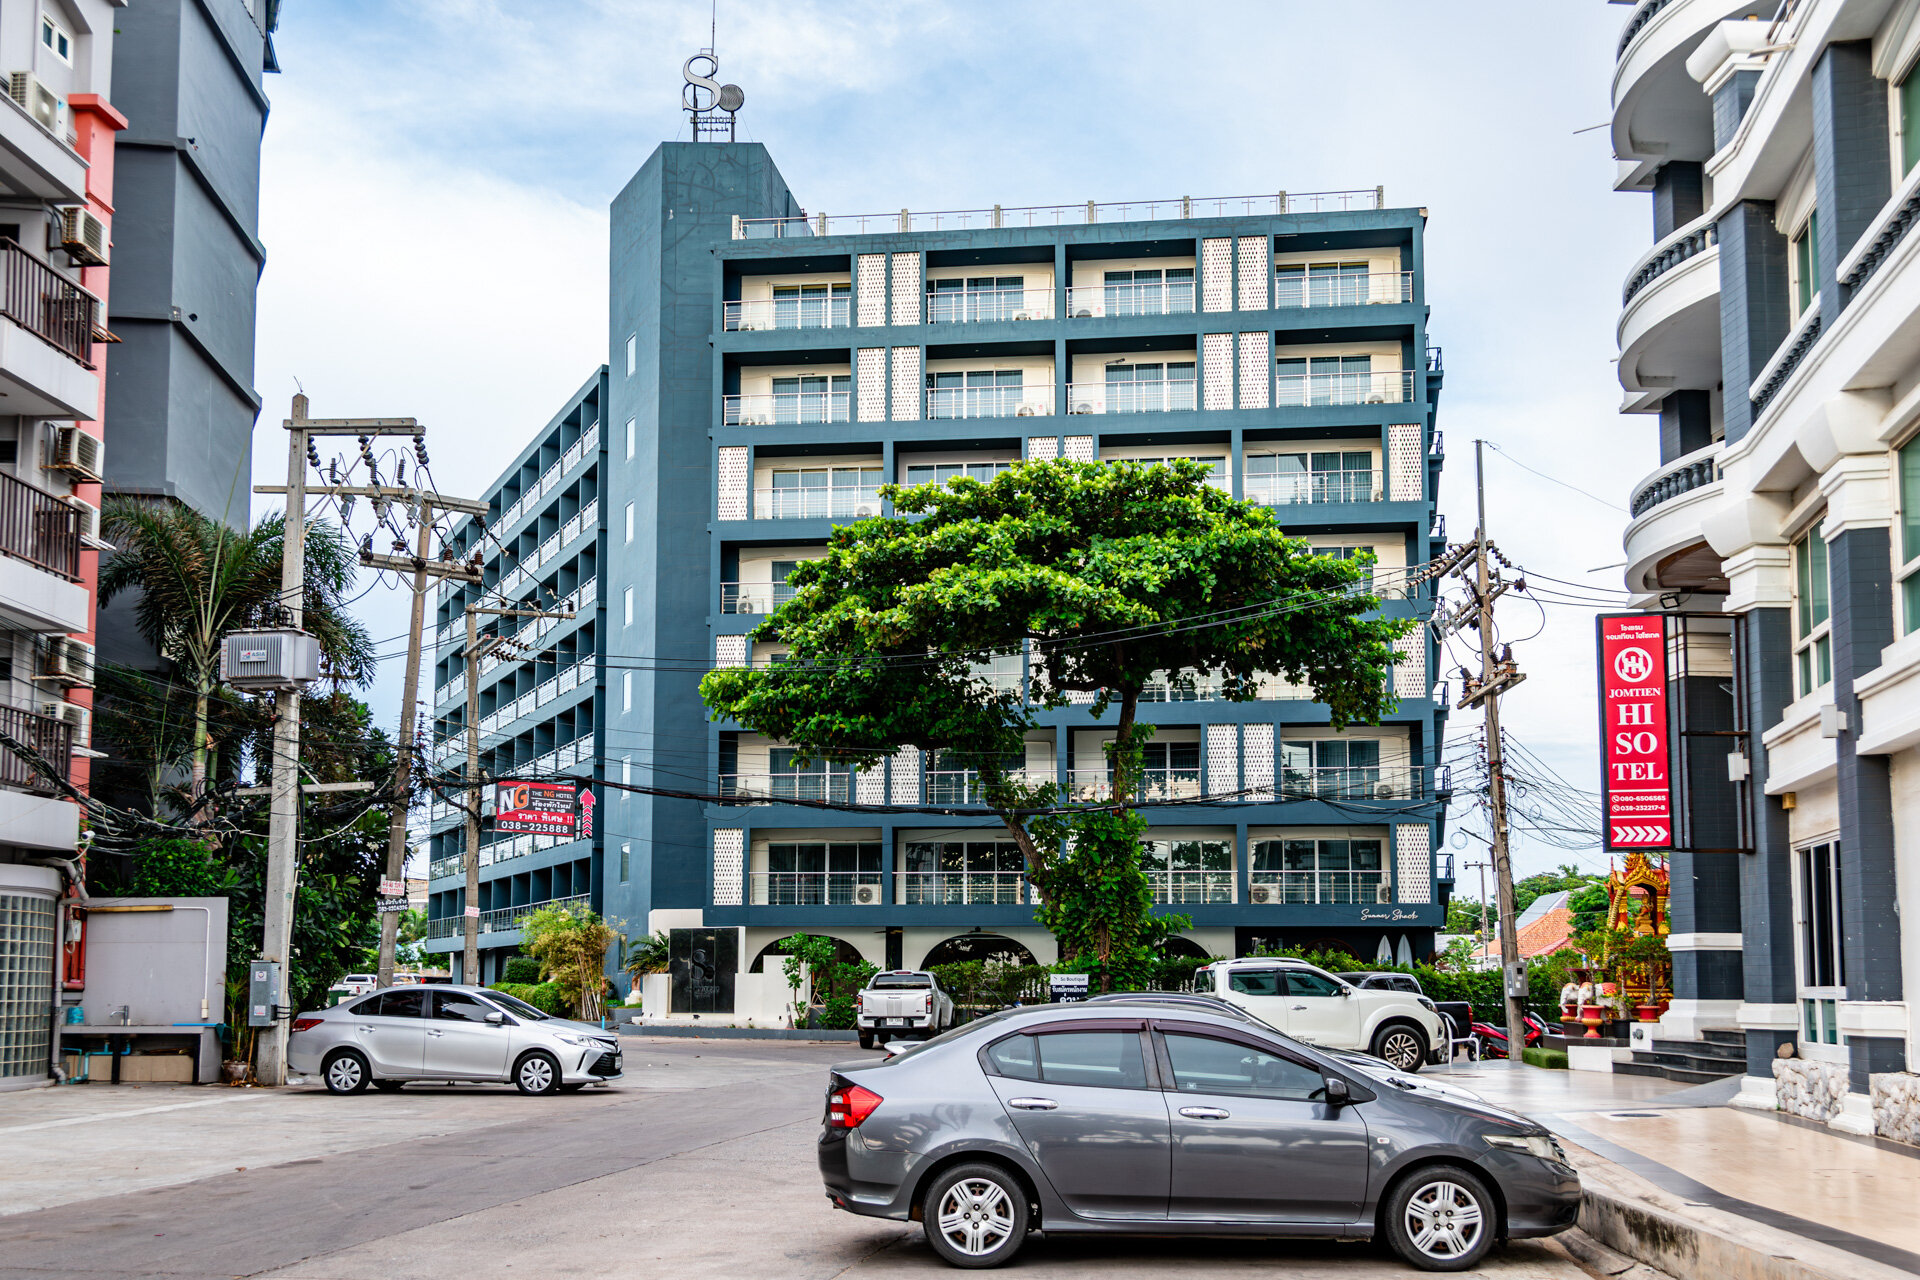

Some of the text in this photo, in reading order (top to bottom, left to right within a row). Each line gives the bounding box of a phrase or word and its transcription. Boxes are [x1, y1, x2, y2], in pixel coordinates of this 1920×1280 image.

[1609, 688, 1661, 698] JOMTIEN
[1617, 703, 1655, 726] HI
[1615, 732, 1658, 755] SO
[1612, 762, 1663, 781] TEL
[499, 785, 529, 815] NG
[543, 790, 555, 798] NG
[540, 812, 563, 822] พิเศษ
[501, 820, 568, 833] 038-225888
[1392, 908, 1418, 920] Shack
